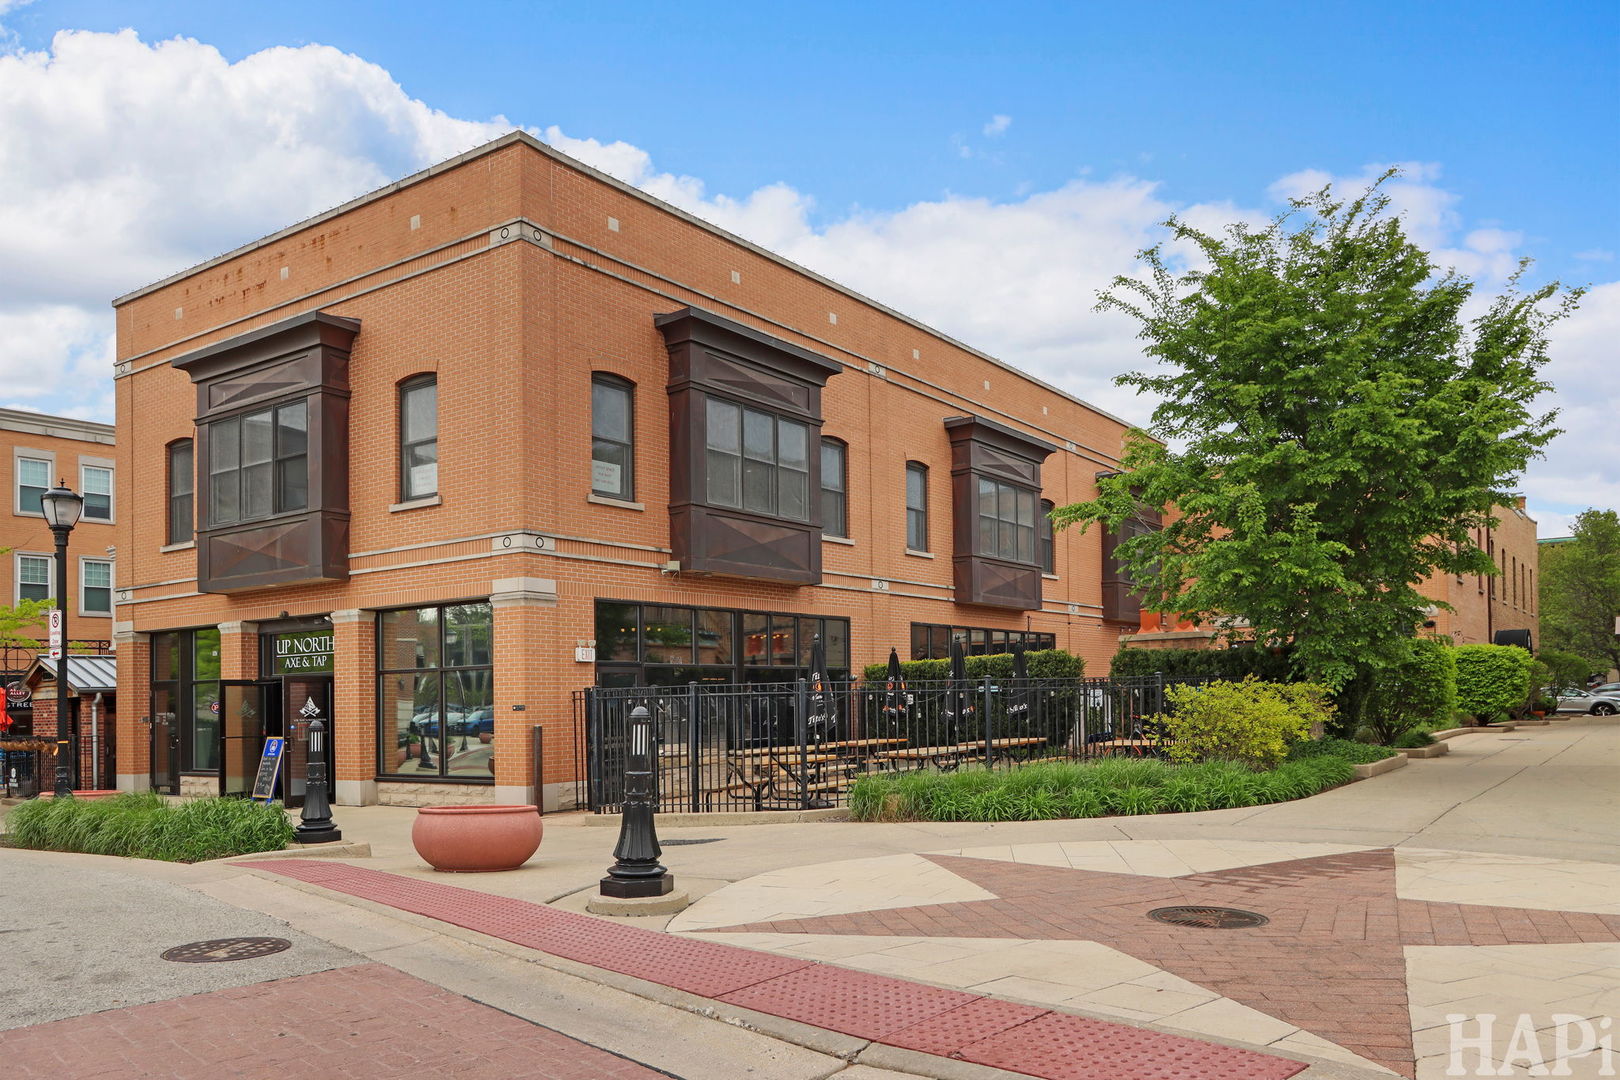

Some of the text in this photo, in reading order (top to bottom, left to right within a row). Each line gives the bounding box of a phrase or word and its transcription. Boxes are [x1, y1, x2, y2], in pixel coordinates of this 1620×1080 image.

[276, 636, 335, 654] UP NORTH
[284, 655, 327, 669] AXE & TAP
